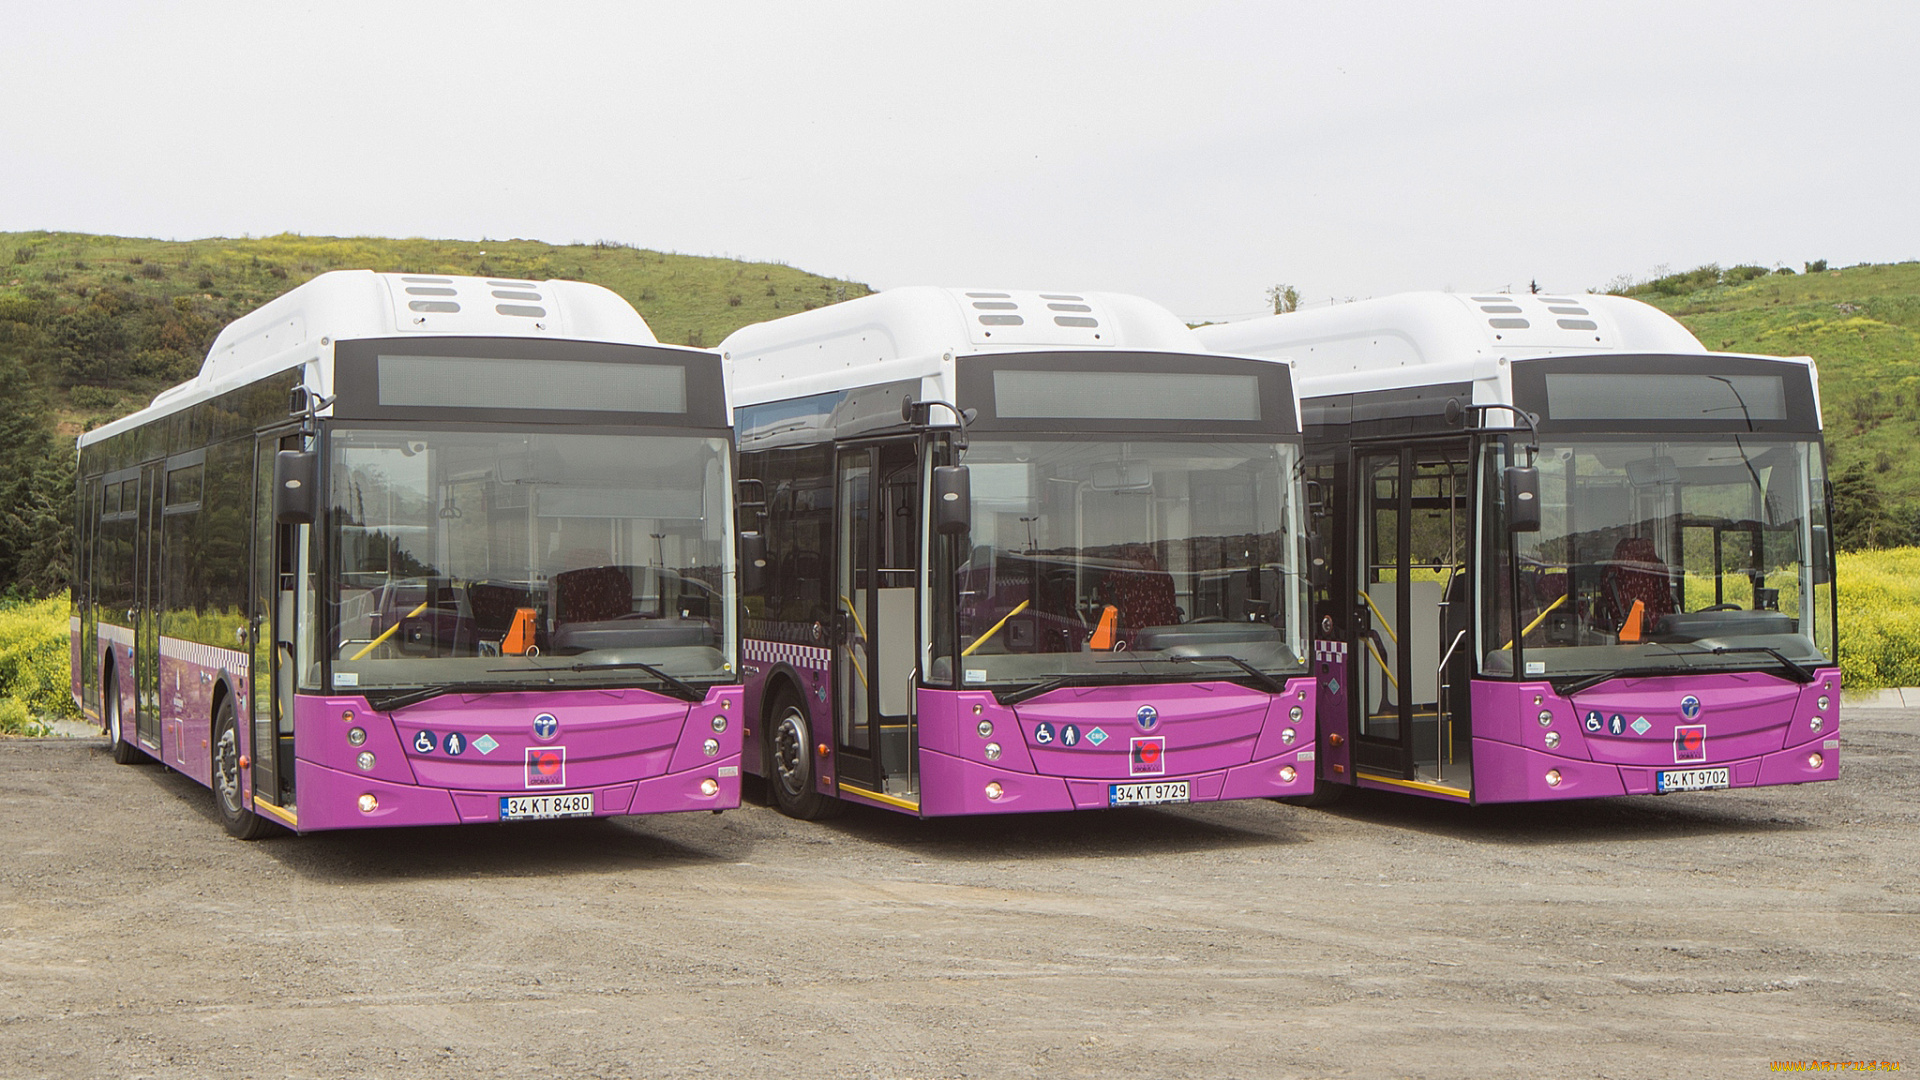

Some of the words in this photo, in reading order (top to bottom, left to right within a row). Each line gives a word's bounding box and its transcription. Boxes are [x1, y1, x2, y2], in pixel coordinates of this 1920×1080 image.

[1664, 773, 1679, 787] 34
[1681, 772, 1696, 786] KT
[1698, 770, 1727, 785] 9702
[1117, 787, 1133, 801] 34
[1136, 786, 1152, 800] KT
[1155, 784, 1187, 799] 9729
[509, 799, 528, 814] 34
[531, 798, 549, 813] KT
[553, 796, 590, 812] 8480
